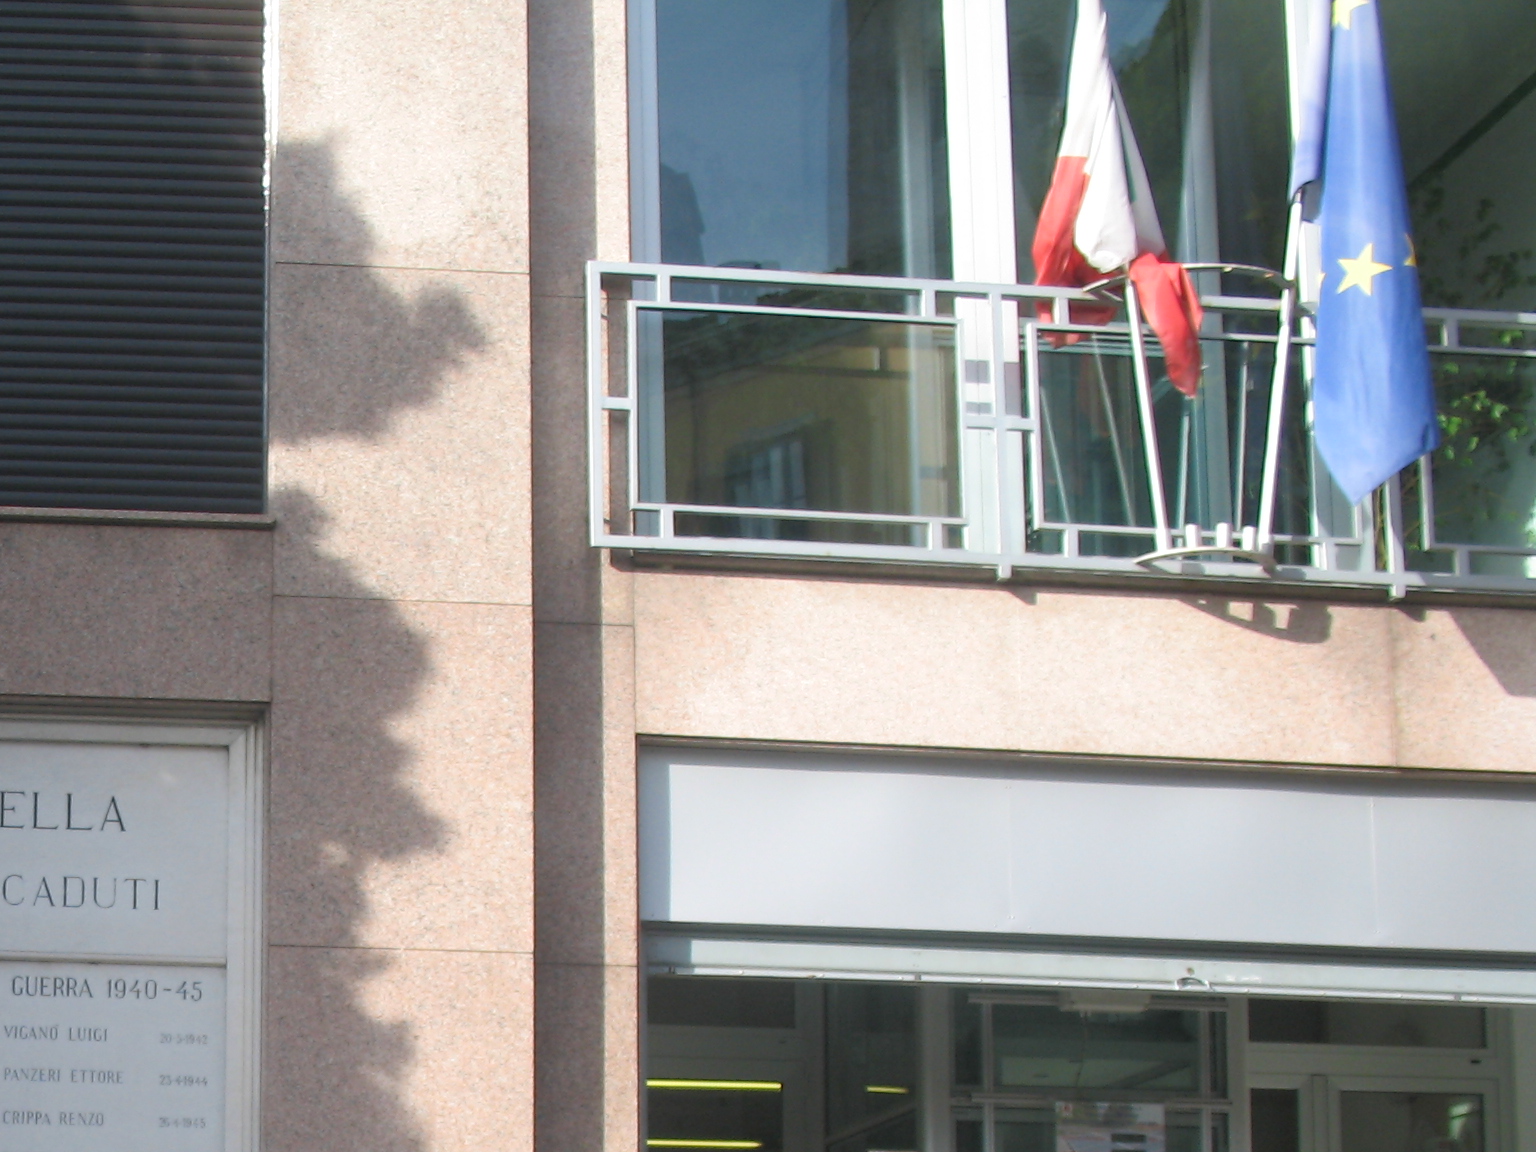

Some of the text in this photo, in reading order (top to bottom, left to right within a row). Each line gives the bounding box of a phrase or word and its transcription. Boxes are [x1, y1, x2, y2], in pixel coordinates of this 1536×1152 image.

[2, 874, 160, 910] CADUTI
[12, 976, 203, 1001] GUERRA 1940-45
[69, 1027, 108, 1042] LUIGI
[4, 1068, 60, 1082] PANZERI
[71, 1069, 124, 1084] ETTORE
[3, 1110, 51, 1125] CRIPPA
[60, 1112, 104, 1126] RENZO
